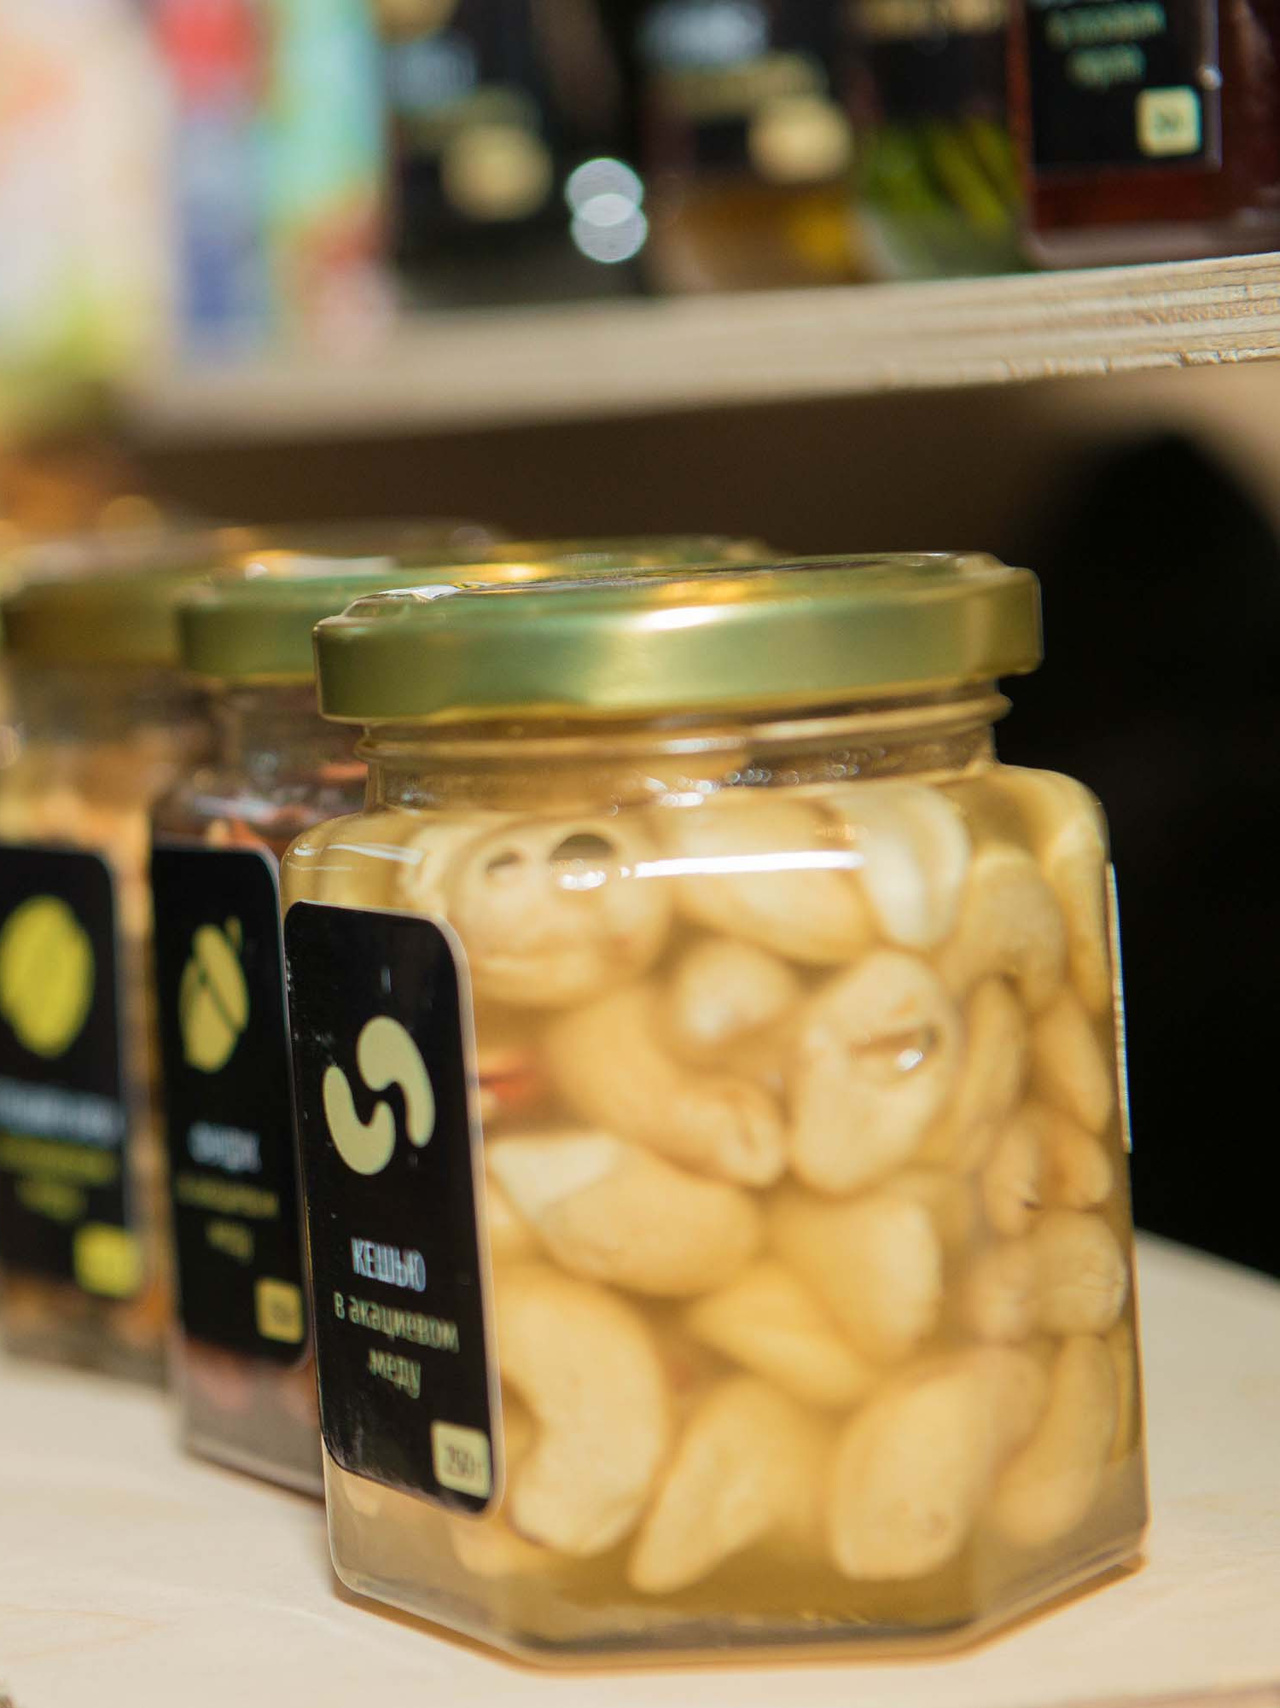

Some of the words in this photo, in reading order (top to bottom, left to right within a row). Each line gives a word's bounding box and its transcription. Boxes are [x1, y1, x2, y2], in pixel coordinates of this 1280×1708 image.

[350, 1237, 426, 1292] КЕШЬЮ
[349, 1295, 460, 1353] акациевом
[368, 1348, 421, 1399] меду
